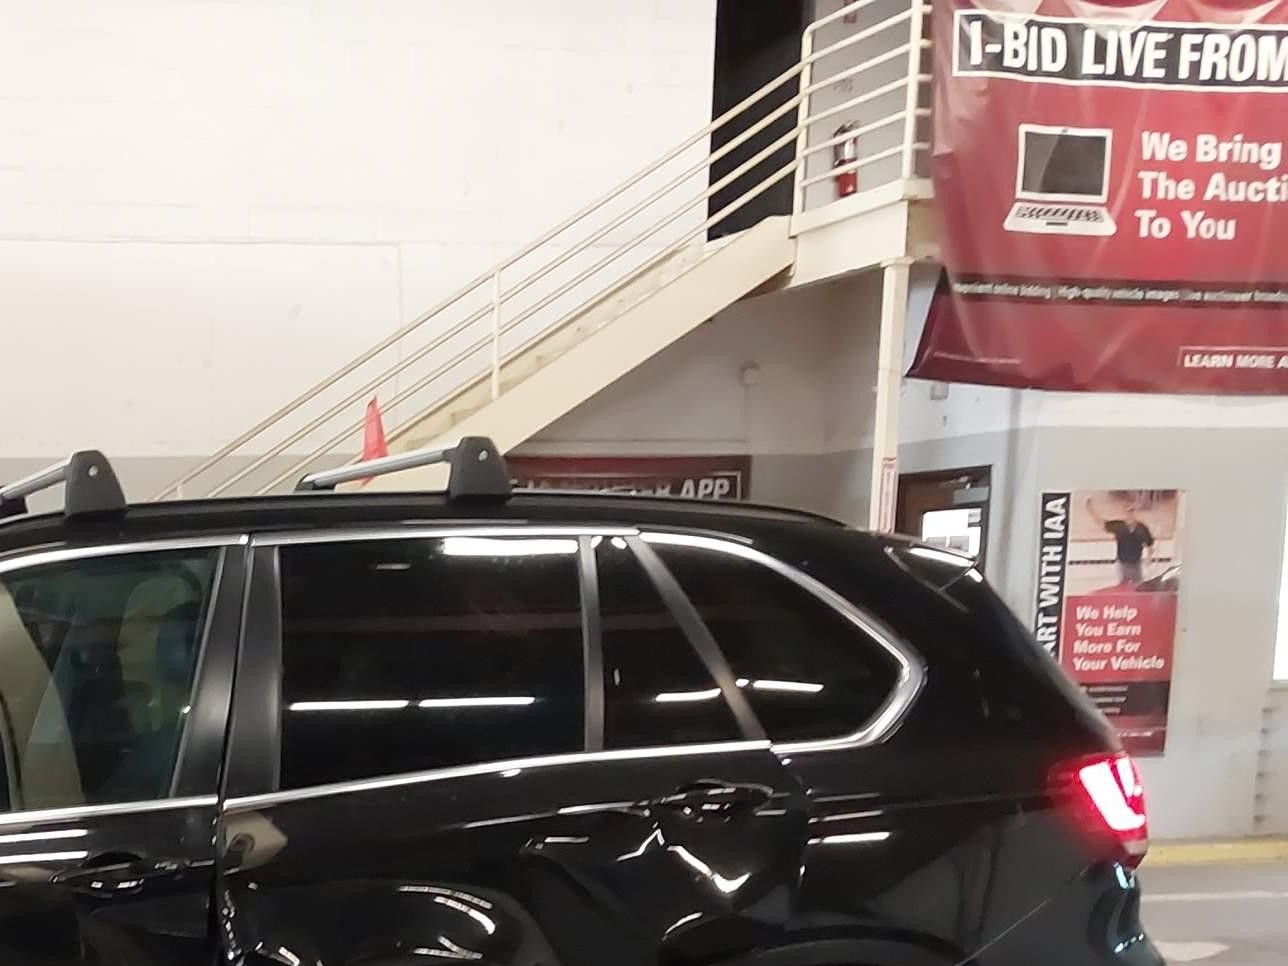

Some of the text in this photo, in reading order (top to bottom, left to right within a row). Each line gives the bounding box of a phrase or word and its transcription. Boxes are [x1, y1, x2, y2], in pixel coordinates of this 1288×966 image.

[1082, 28, 1174, 79] LIVE
[1178, 32, 1288, 82] FROM
[1141, 130, 1283, 171] We Bring
[1137, 170, 1288, 202] The Aucti
[1134, 208, 1237, 240] To You
[1184, 353, 1234, 368] LEARN
[679, 478, 730, 500] APP
[1043, 496, 1068, 540] IAA
[1039, 545, 1063, 608] WITH
[1076, 604, 1138, 622] We Help
[1075, 622, 1142, 637] You Earn
[1073, 639, 1142, 654] More For
[1072, 655, 1165, 671] Your Vehicle
